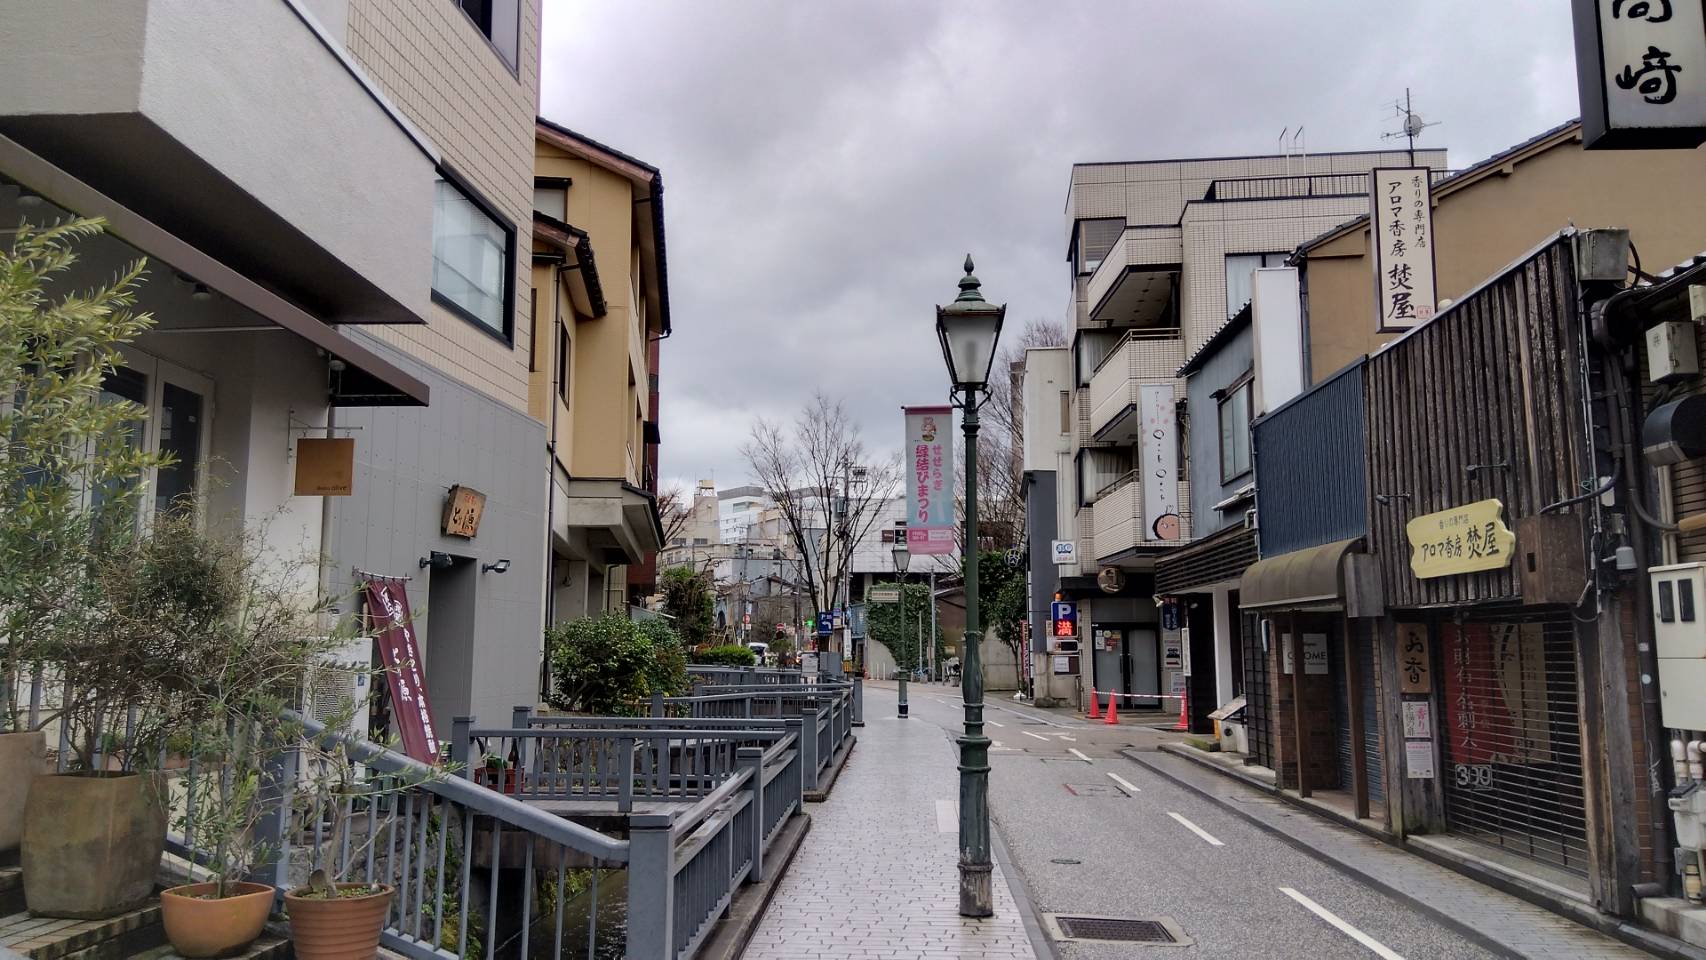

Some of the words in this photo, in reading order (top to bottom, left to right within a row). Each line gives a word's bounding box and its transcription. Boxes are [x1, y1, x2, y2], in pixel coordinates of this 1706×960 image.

[1388, 181, 1407, 257] アロマ香房
[1411, 175, 1426, 248] 香りの専門店
[1387, 263, 1416, 319] 焚屋
[915, 444, 929, 523] 縁結びまつり
[932, 444, 943, 491] せせらぎ
[1421, 533, 1462, 562] アロマ香房
[1467, 521, 1500, 560] 焚屋
[1057, 620, 1072, 636] 満
[1058, 603, 1071, 619] P
